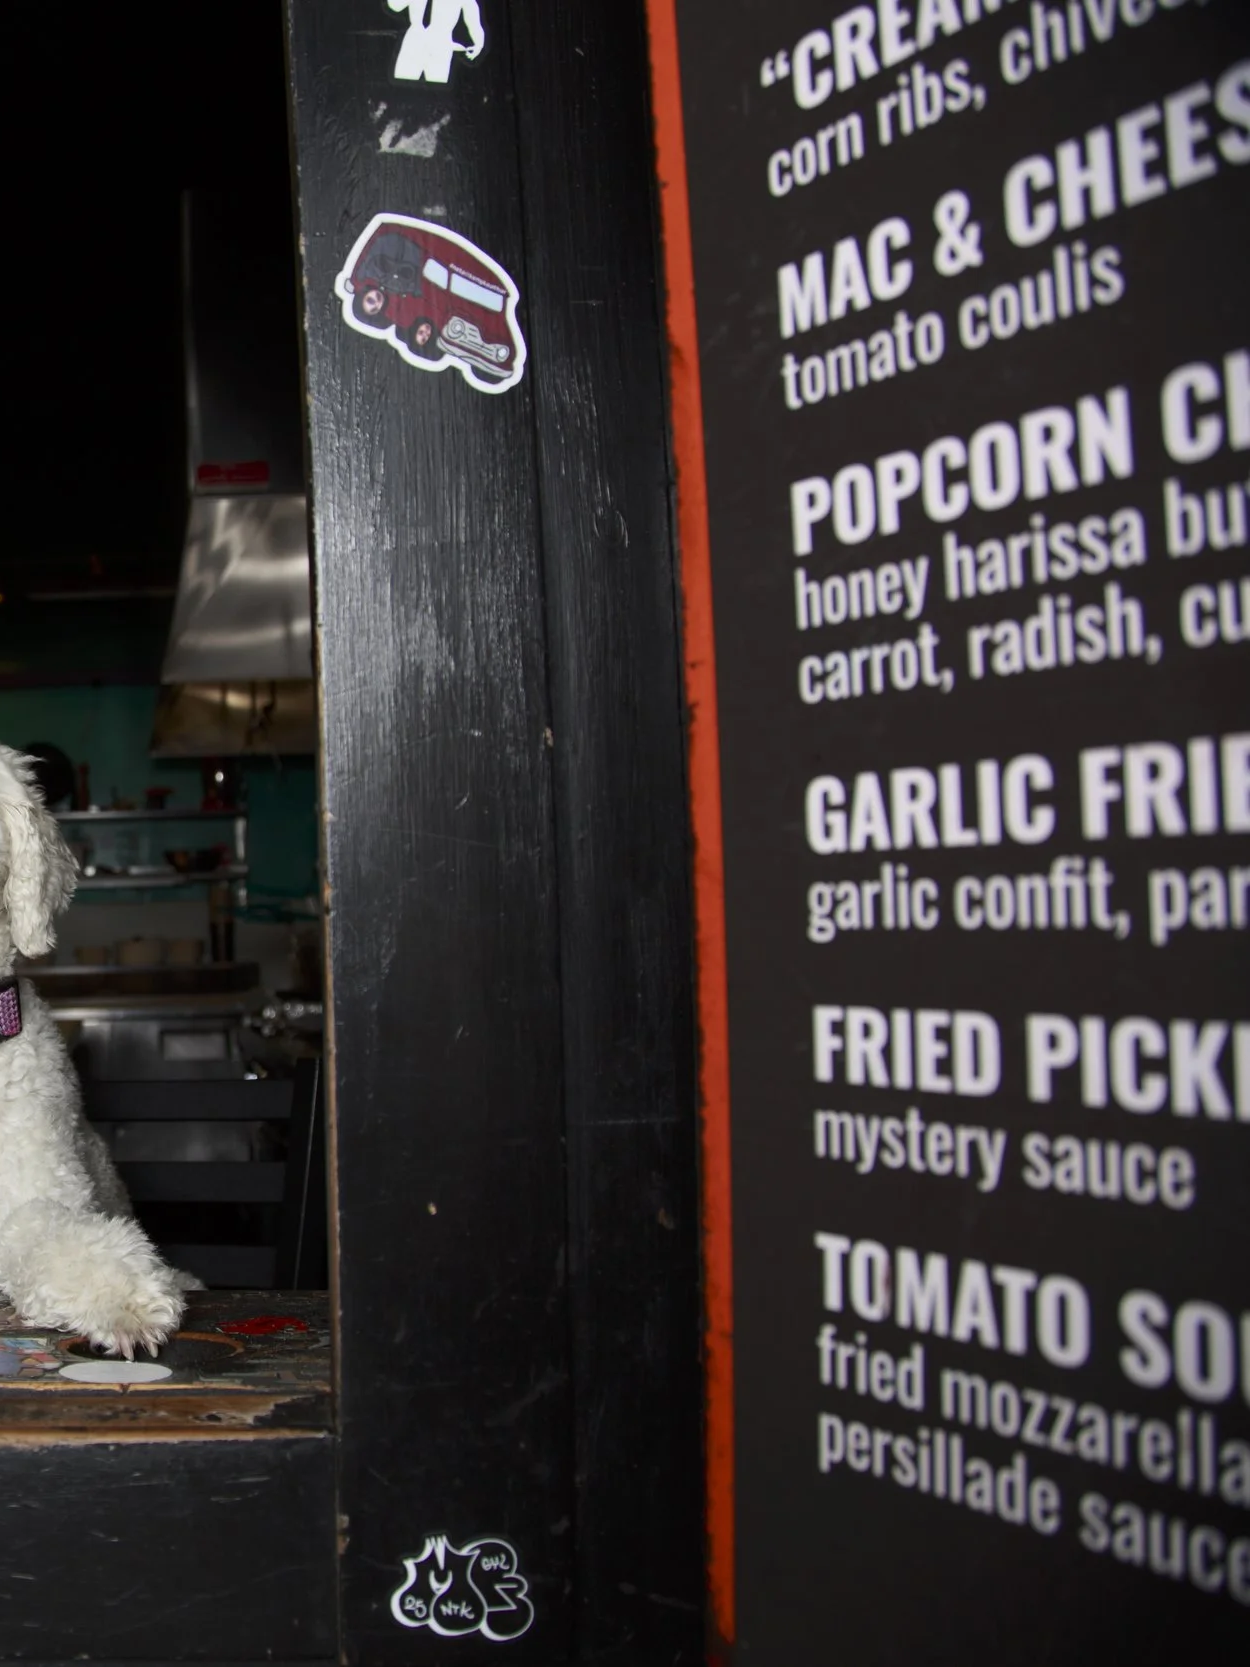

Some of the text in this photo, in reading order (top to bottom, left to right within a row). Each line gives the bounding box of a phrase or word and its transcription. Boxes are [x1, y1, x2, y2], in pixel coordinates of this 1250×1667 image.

[767, 0, 1188, 198] corn ribs, chiv
[776, 216, 914, 340] MAC
[932, 189, 984, 277] &
[780, 240, 1125, 411] tomato coulis
[789, 385, 1134, 557] POPCORN
[793, 477, 1250, 631] honey harissa bu
[798, 621, 955, 705] carrot,
[967, 581, 1163, 680] radish,
[804, 753, 1056, 856] GARLIC
[807, 861, 940, 944] garlic
[953, 855, 1131, 939] confit,
[812, 1004, 1002, 1097] FRIED
[813, 1106, 1195, 1210] mystery sauce
[813, 1231, 1250, 1401] TOMATO SO
[816, 1323, 1250, 1502] fried mozzarella
[818, 1412, 1250, 1603] persillade sauce
